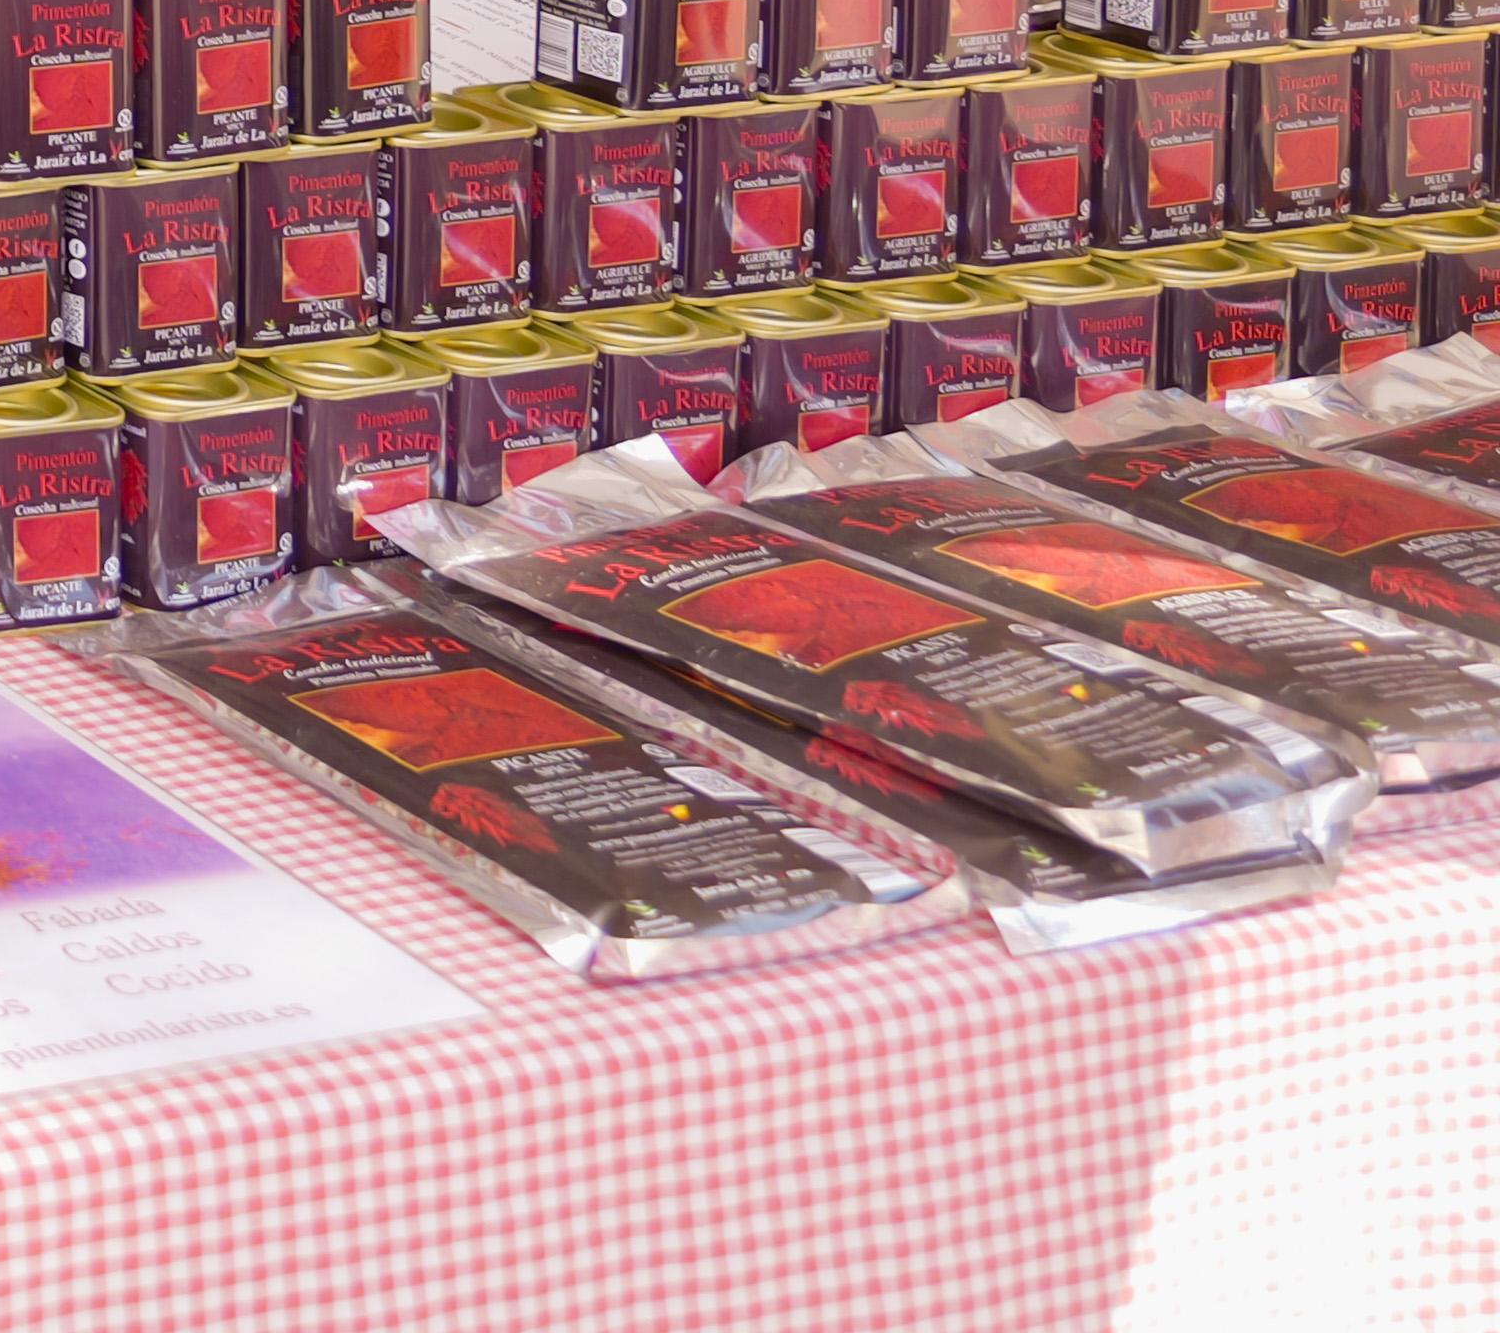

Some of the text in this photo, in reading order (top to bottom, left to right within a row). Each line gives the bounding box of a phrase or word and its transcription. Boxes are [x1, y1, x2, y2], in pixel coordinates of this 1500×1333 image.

[683, 64, 737, 76] AGRIDULCE
[17, 449, 97, 472] Pimentón
[39, 472, 113, 497] Ristra
[33, 581, 82, 597] PICANTE
[490, 748, 589, 771] PICANTE
[20, 894, 166, 933] Fabada
[61, 928, 203, 966] Caldos
[105, 957, 253, 998] Cocido
